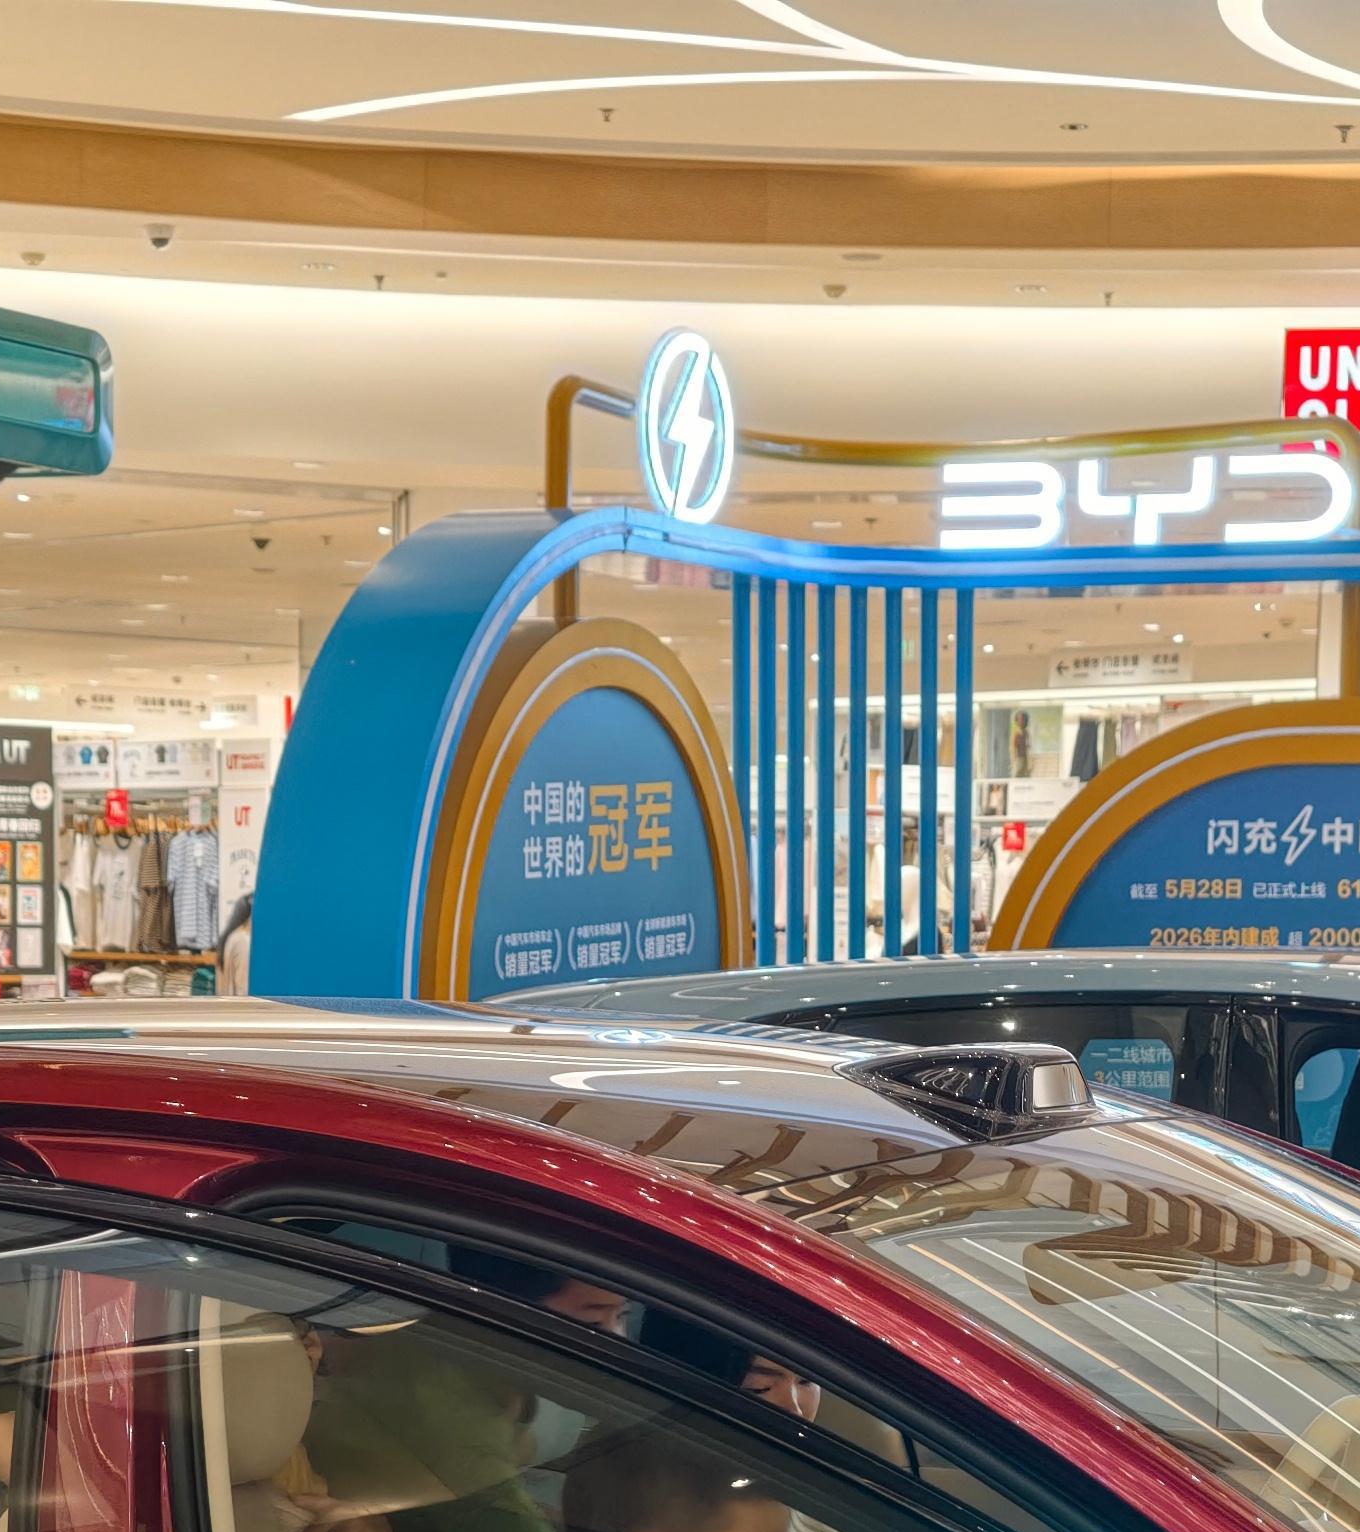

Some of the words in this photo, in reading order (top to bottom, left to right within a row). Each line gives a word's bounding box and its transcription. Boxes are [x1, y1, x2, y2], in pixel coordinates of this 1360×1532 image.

[940, 454, 1354, 550] BYD
[2, 738, 31, 764] UT
[234, 805, 251, 826] UT
[523, 780, 584, 826] 中国的
[588, 781, 672, 874] 冠军
[1207, 817, 1278, 856] 闪充
[523, 834, 584, 879] 世界的
[1130, 883, 1158, 899] 截至
[1165, 878, 1243, 899] 5月28日
[1253, 882, 1327, 899] 已正式上线
[645, 932, 687, 960] 销量冠军
[1149, 926, 1280, 947] 2026年内建成
[505, 949, 552, 978] 销量冠军
[577, 940, 621, 969] 销量冠军
[1090, 1047, 1172, 1064] 一二线城市
